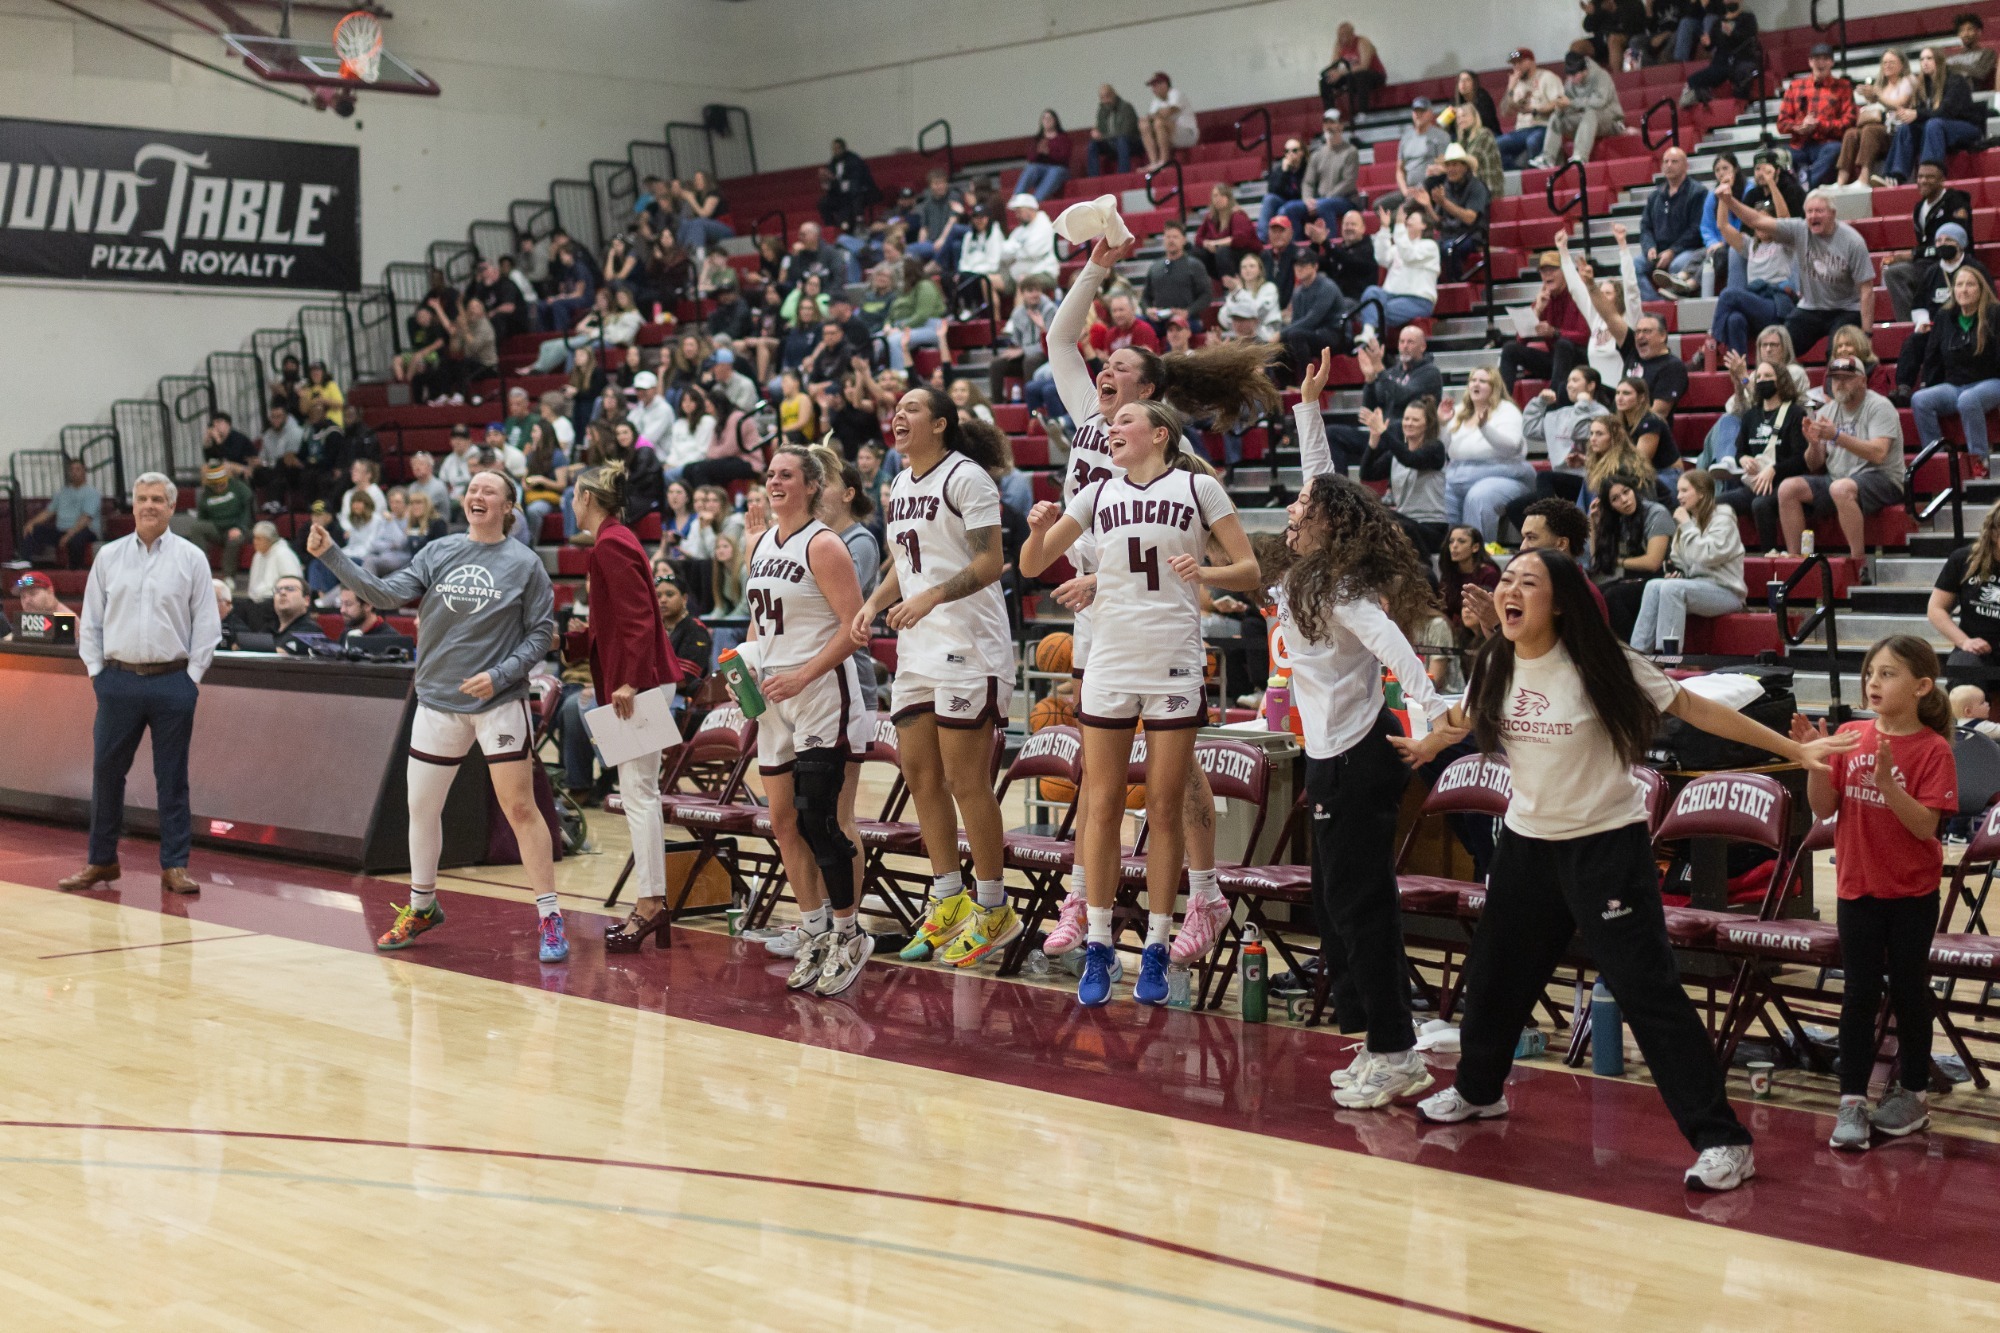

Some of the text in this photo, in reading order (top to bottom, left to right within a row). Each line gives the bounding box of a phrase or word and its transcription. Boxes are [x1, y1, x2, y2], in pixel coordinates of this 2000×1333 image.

[0, 143, 331, 254] UND TABLE
[91, 244, 296, 279] PIZZA ROYALTY
[1098, 500, 1195, 534] WILDCATS
[1128, 536, 1160, 591] 4
[435, 584, 502, 599] CHICO STATE
[21, 615, 45, 631] POSS
[747, 588, 784, 636] 24
[726, 667, 742, 685] G
[1020, 732, 1081, 766] CHICO STATE
[1216, 748, 1256, 785] STATE
[1438, 761, 1481, 793] CHICO
[676, 807, 722, 823] WILDCATS
[1677, 781, 1728, 816] CHICO
[1728, 782, 1776, 824] STATE
[1014, 846, 1061, 864] WILDCATS
[1729, 929, 1811, 952] WILDCATS
[1246, 965, 1260, 981] G
